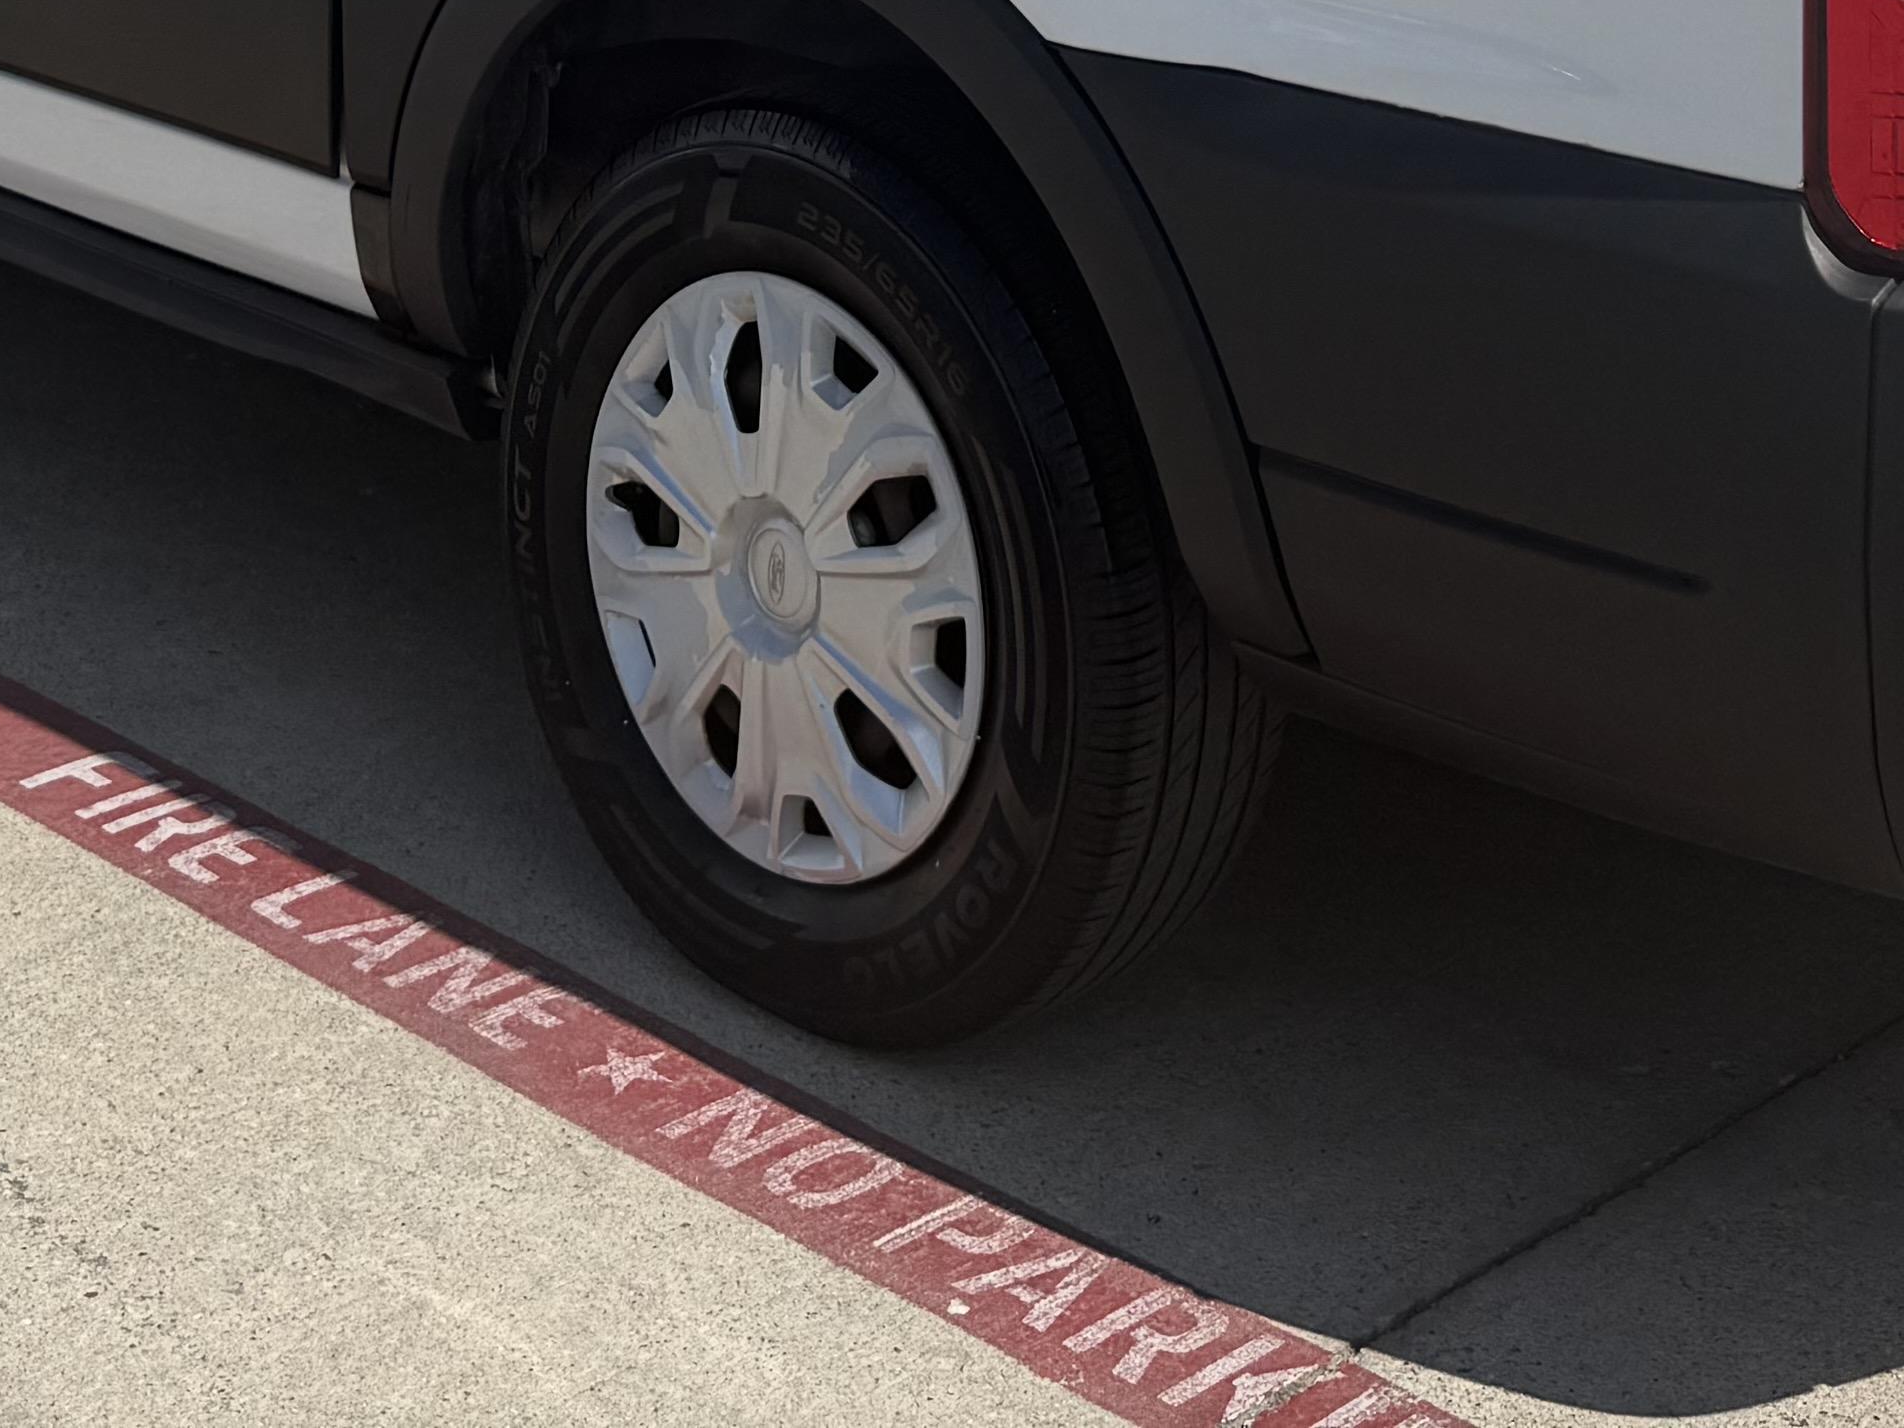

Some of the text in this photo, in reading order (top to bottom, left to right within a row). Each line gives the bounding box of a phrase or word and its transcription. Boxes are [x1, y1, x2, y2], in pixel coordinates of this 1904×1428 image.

[18, 748, 304, 886] FIRE
[249, 866, 568, 1052] LANE
[653, 1087, 908, 1211] NO
